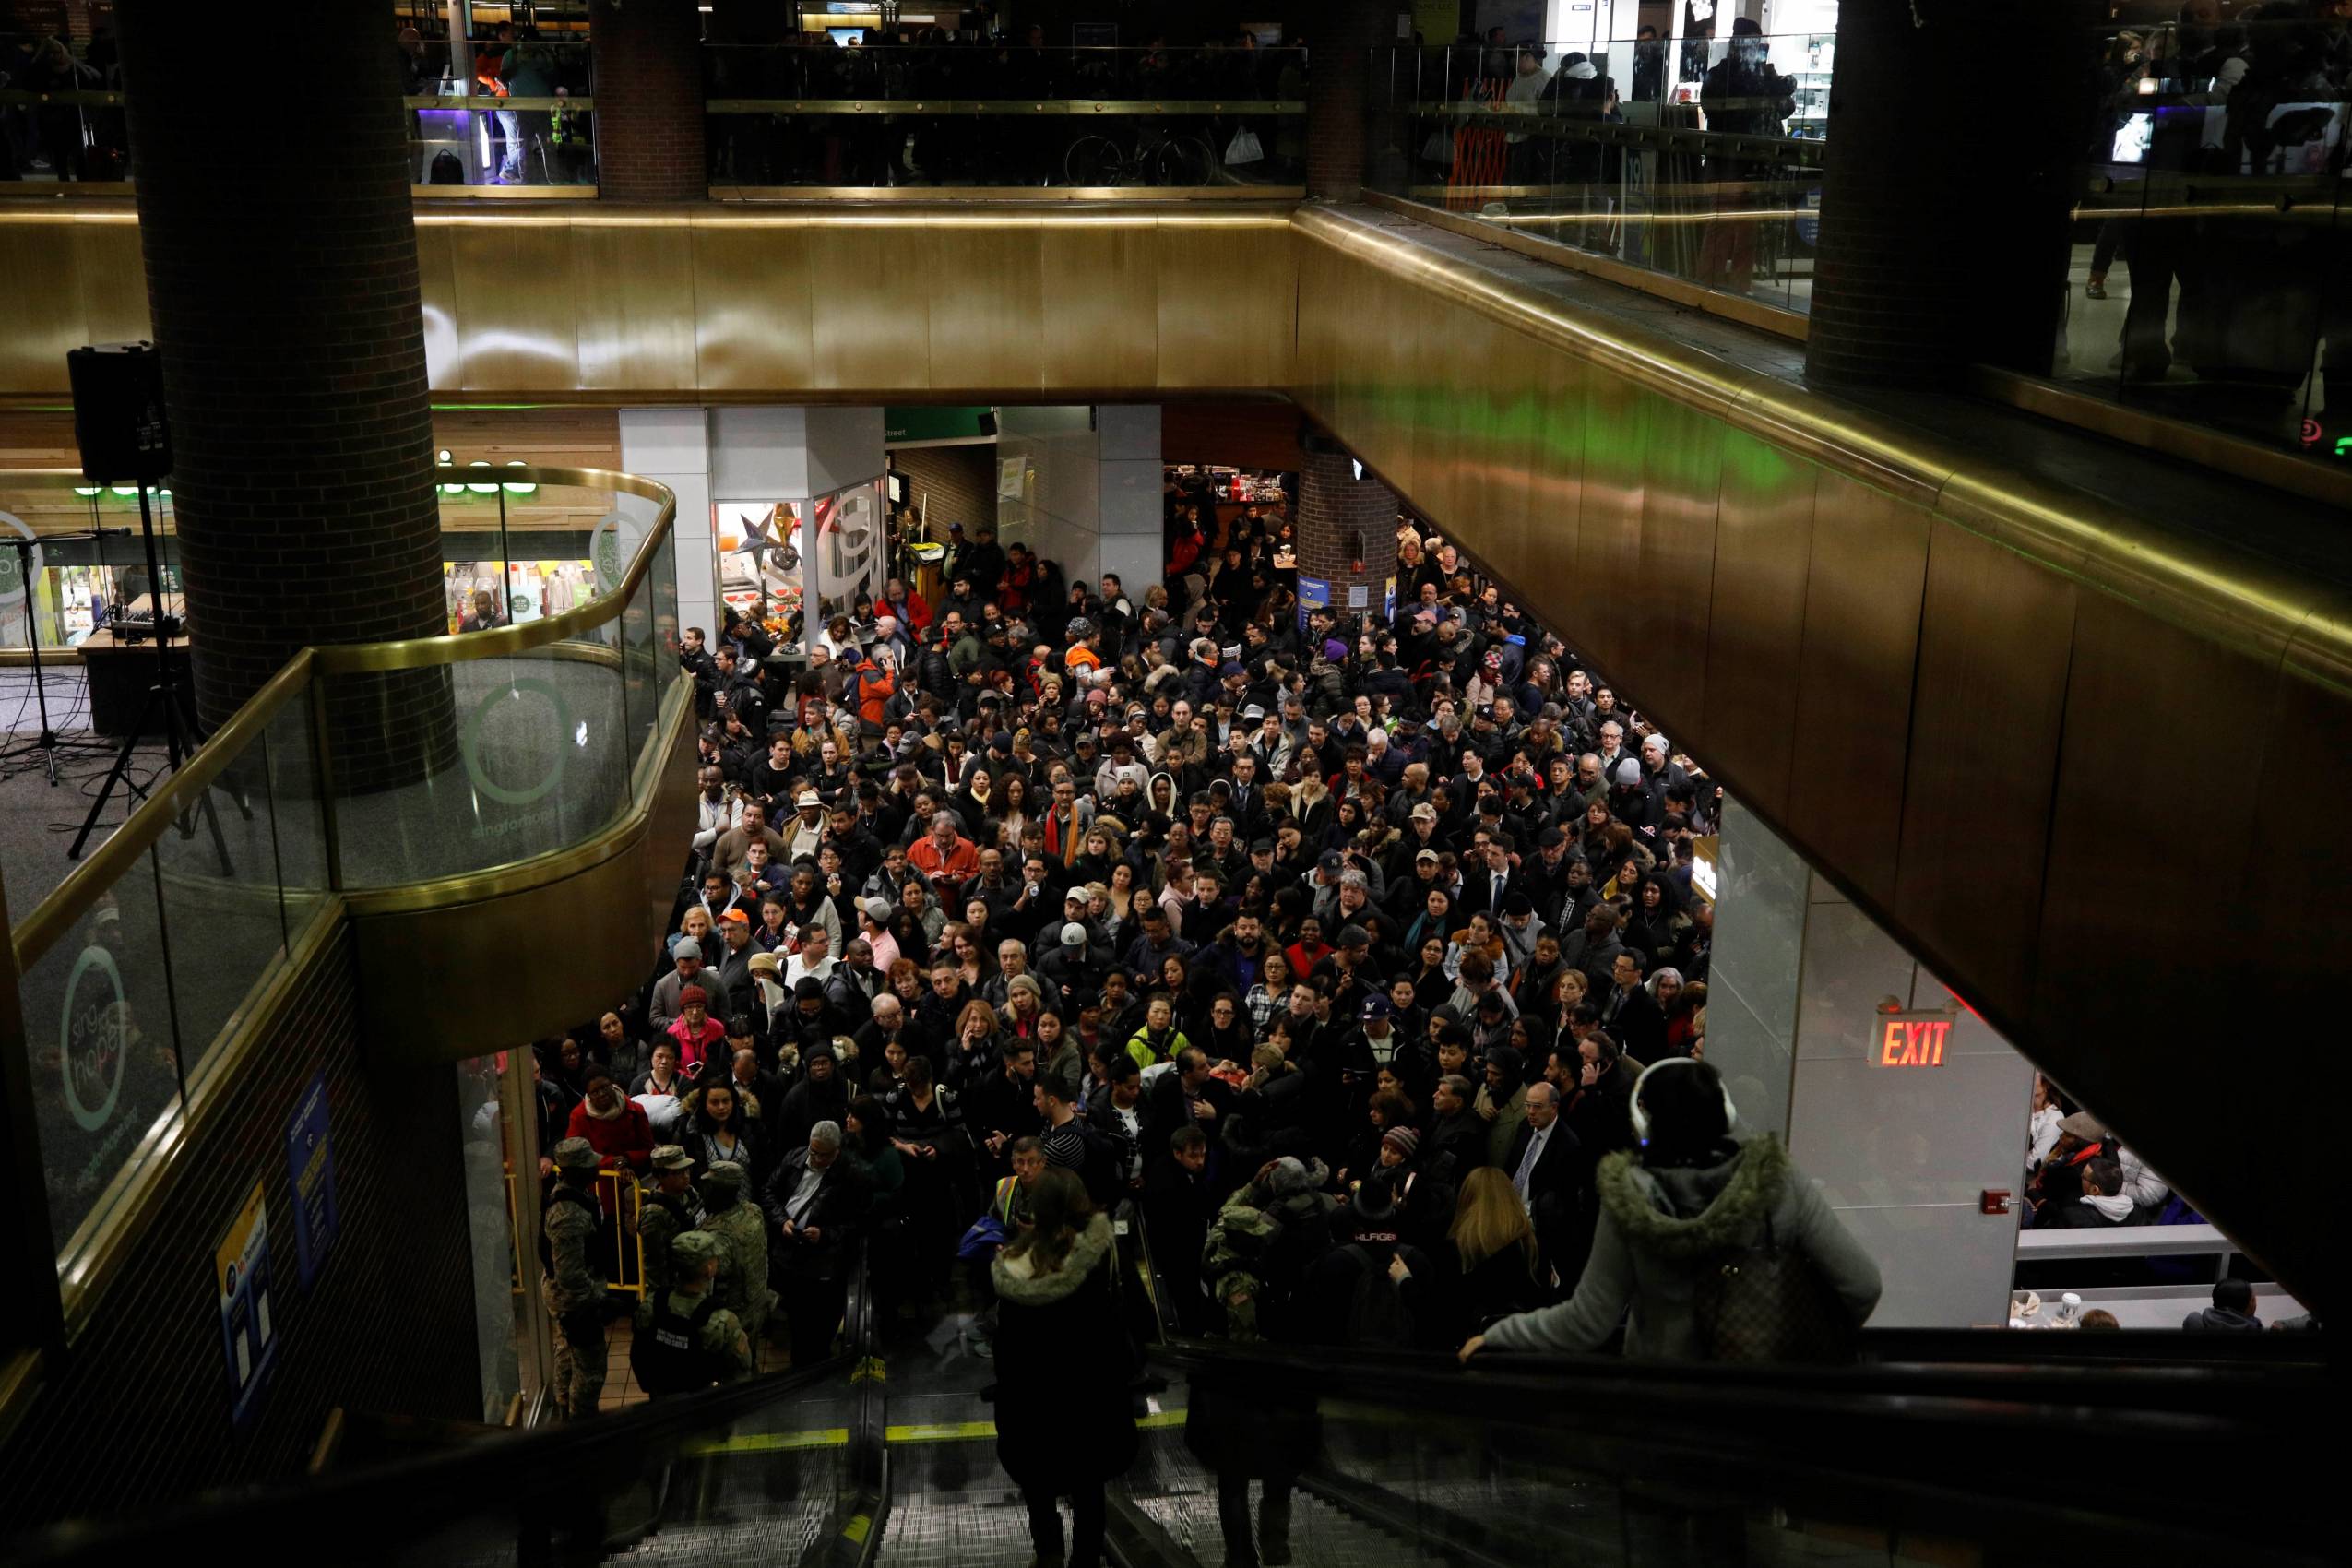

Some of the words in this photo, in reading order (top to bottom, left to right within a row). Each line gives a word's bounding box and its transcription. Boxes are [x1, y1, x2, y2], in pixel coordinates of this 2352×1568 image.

[73, 1004, 98, 1047] sing
[1882, 1021, 1951, 1064] EXIT
[73, 1023, 119, 1093] hope
